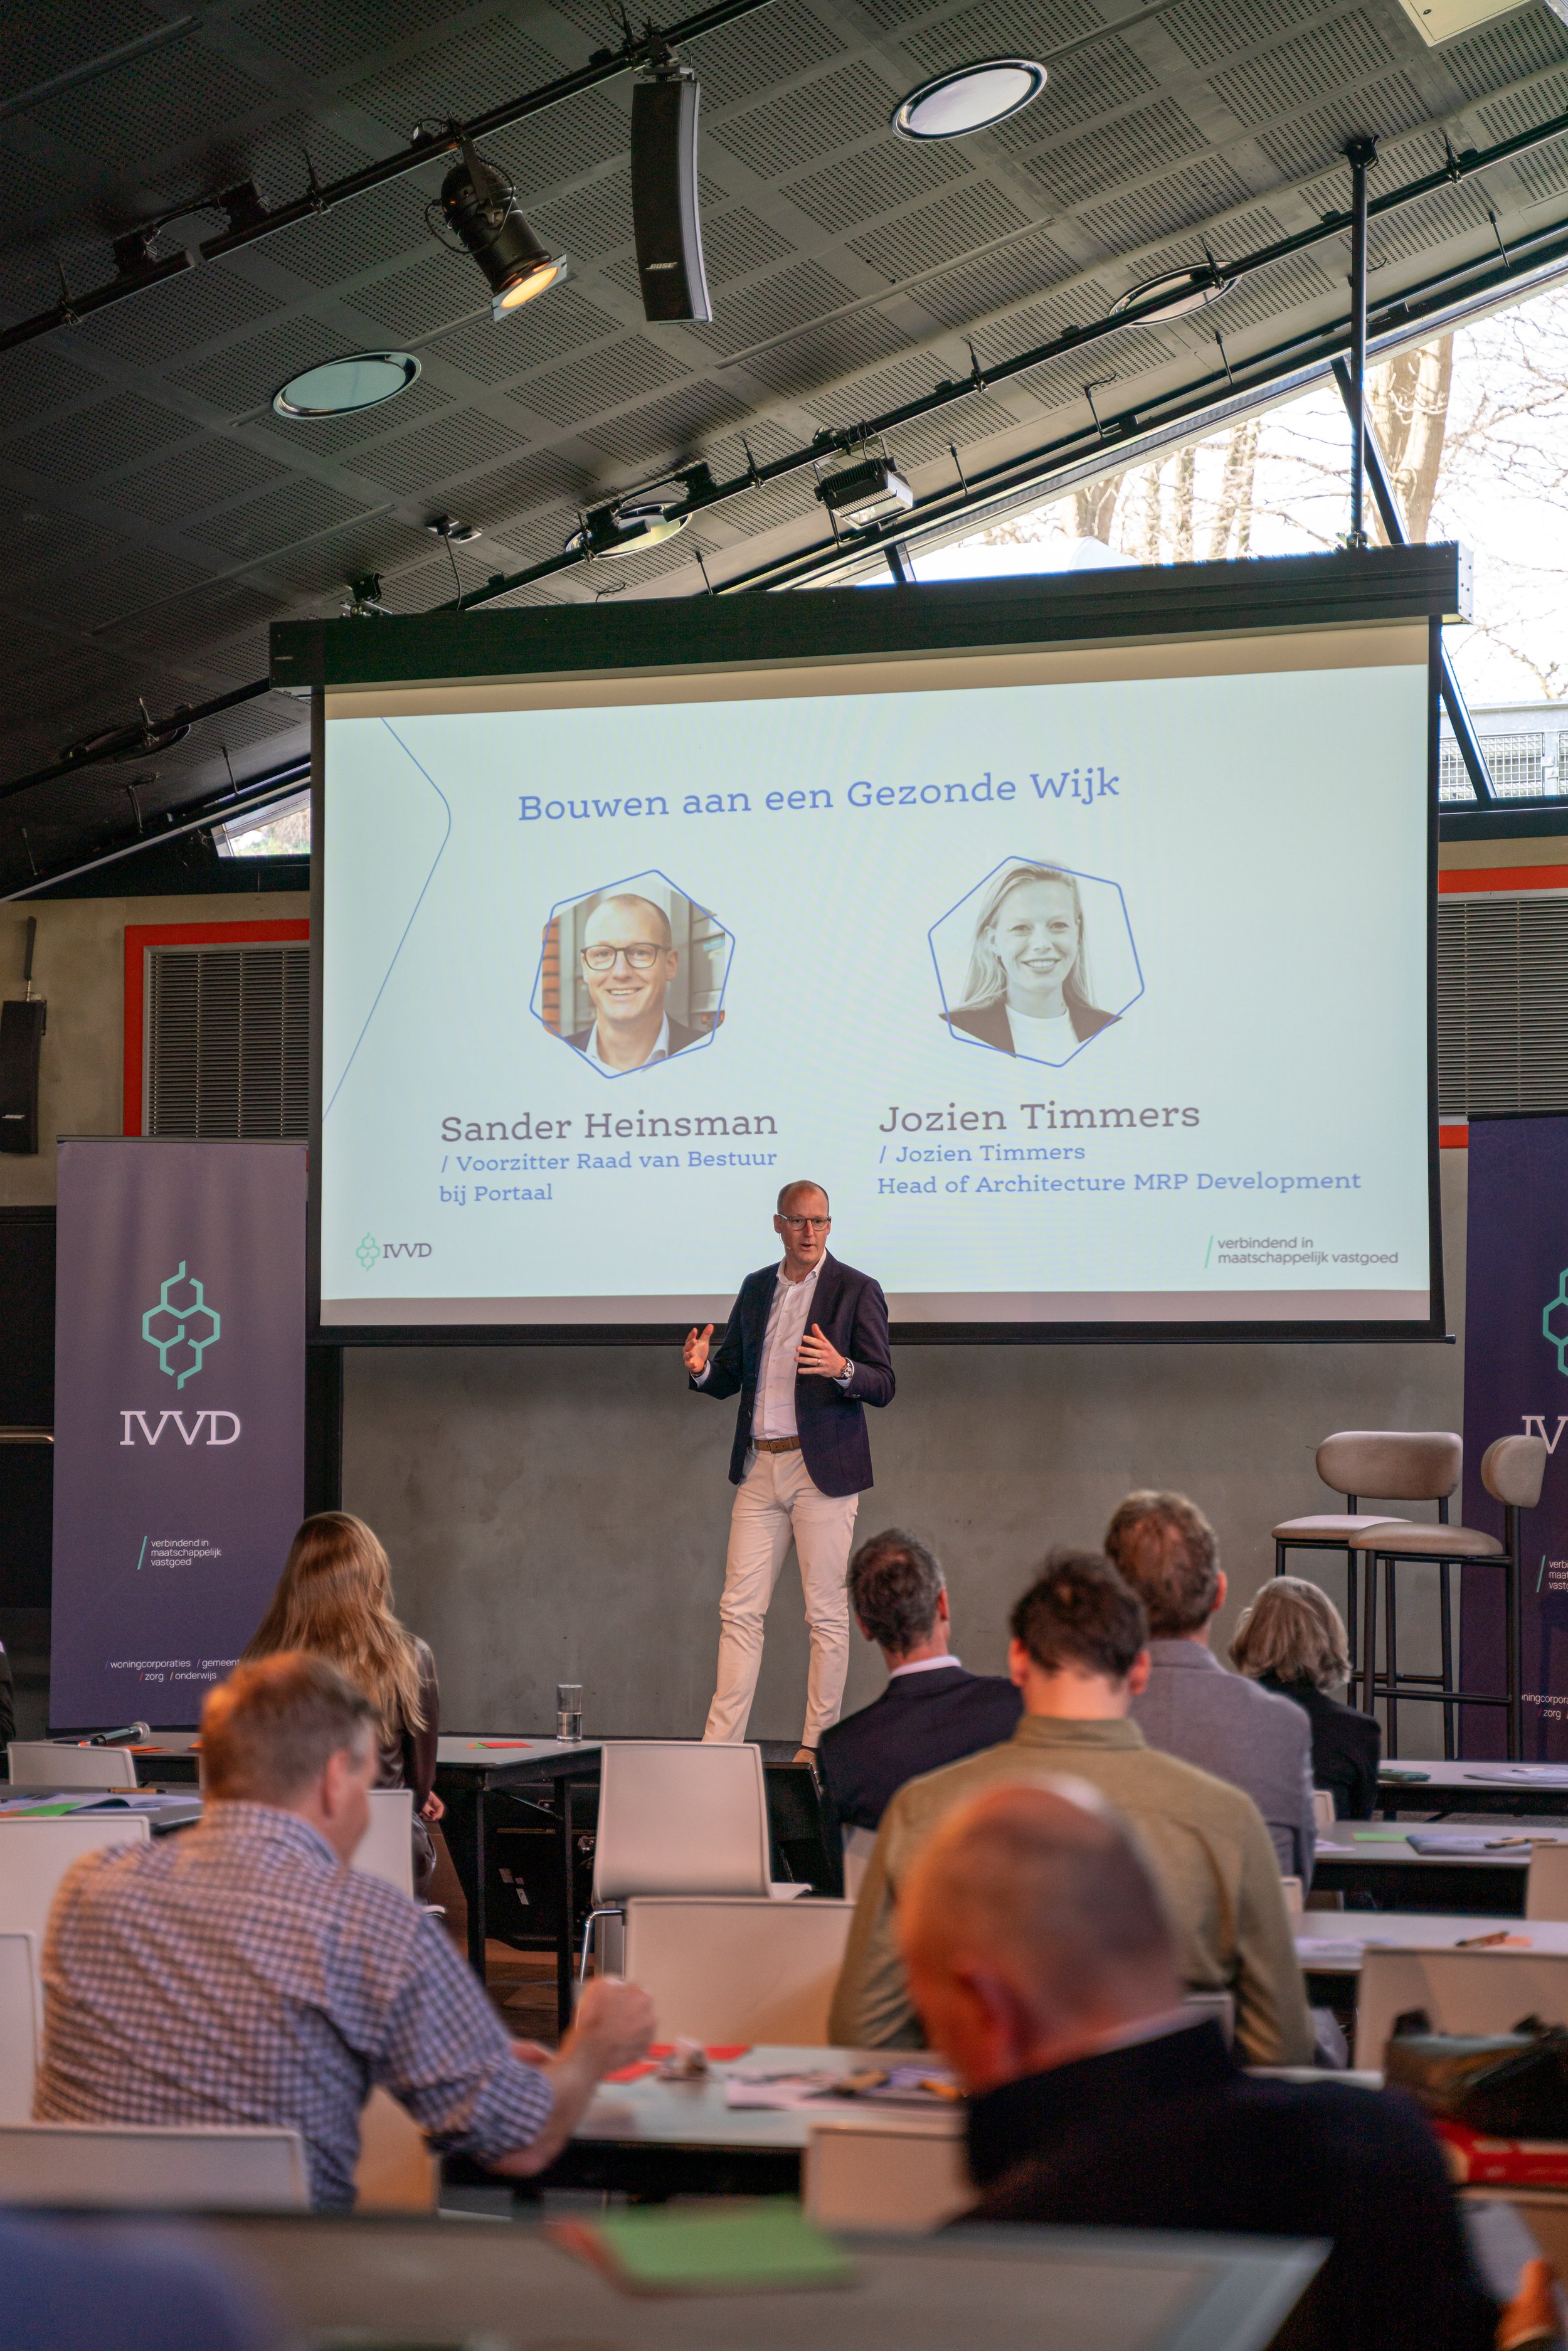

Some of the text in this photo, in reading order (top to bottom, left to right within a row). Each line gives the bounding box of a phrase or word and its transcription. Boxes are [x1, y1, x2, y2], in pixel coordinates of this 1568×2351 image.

[645, 262, 677, 270] BOSE
[519, 767, 1119, 820] Bouwen aan een Gezonde Wijk
[879, 1100, 1199, 1132] Jozien Timmers
[442, 1110, 778, 1142] Sander Heinsman
[457, 1154, 569, 1171] Voorzitter
[577, 1151, 632, 1169] Raad
[639, 1155, 680, 1167] van
[688, 1151, 777, 1167] Bestuur
[896, 1144, 972, 1162] Jozien
[980, 1144, 1084, 1161] Timmers
[878, 1171, 1360, 1194] Head of Architecture MRP Development
[440, 1183, 553, 1206] bij Portaal
[383, 1243, 432, 1258] IVVD
[1218, 1237, 1313, 1248] verbindend in
[1219, 1252, 1398, 1265] maatschappelijk vastgoed
[120, 1411, 241, 1445] IVVD
[151, 1539, 209, 1547] verbindend in
[151, 1548, 221, 1559] maatschappelijk
[151, 1558, 191, 1568] vastgoed
